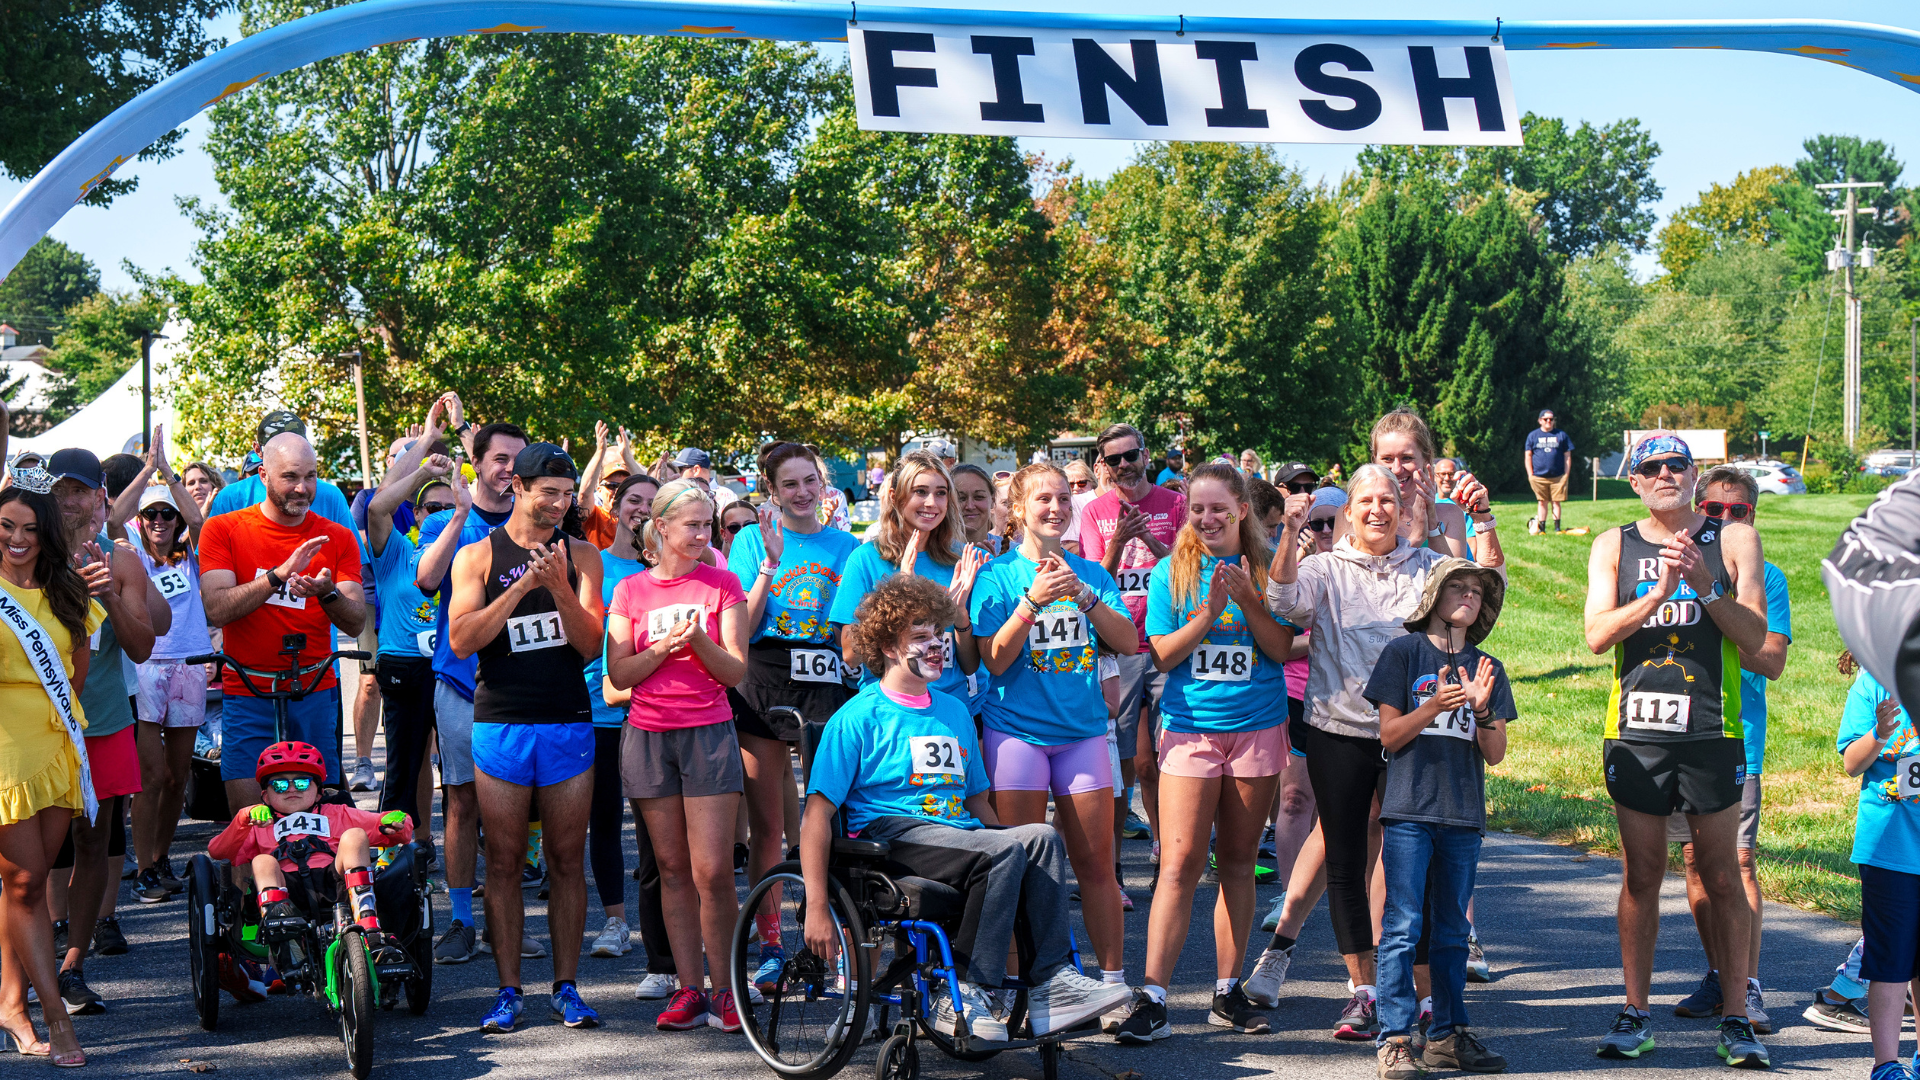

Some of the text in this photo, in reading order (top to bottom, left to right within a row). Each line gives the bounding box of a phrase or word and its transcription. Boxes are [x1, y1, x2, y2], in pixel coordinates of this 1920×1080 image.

[863, 29, 1506, 132] FINISH
[154, 573, 186, 594] 53
[770, 565, 808, 597] Duckie
[1647, 584, 1691, 595] FR
[514, 617, 563, 646] 111
[1034, 617, 1081, 644] 147
[0, 597, 78, 732] Miss Pennsylvania
[795, 653, 838, 678] 164
[1196, 649, 1247, 675] 148
[1631, 698, 1683, 726] 112
[924, 742, 956, 768] 32
[1883, 722, 1919, 762] Ducki
[278, 815, 326, 835] 141
